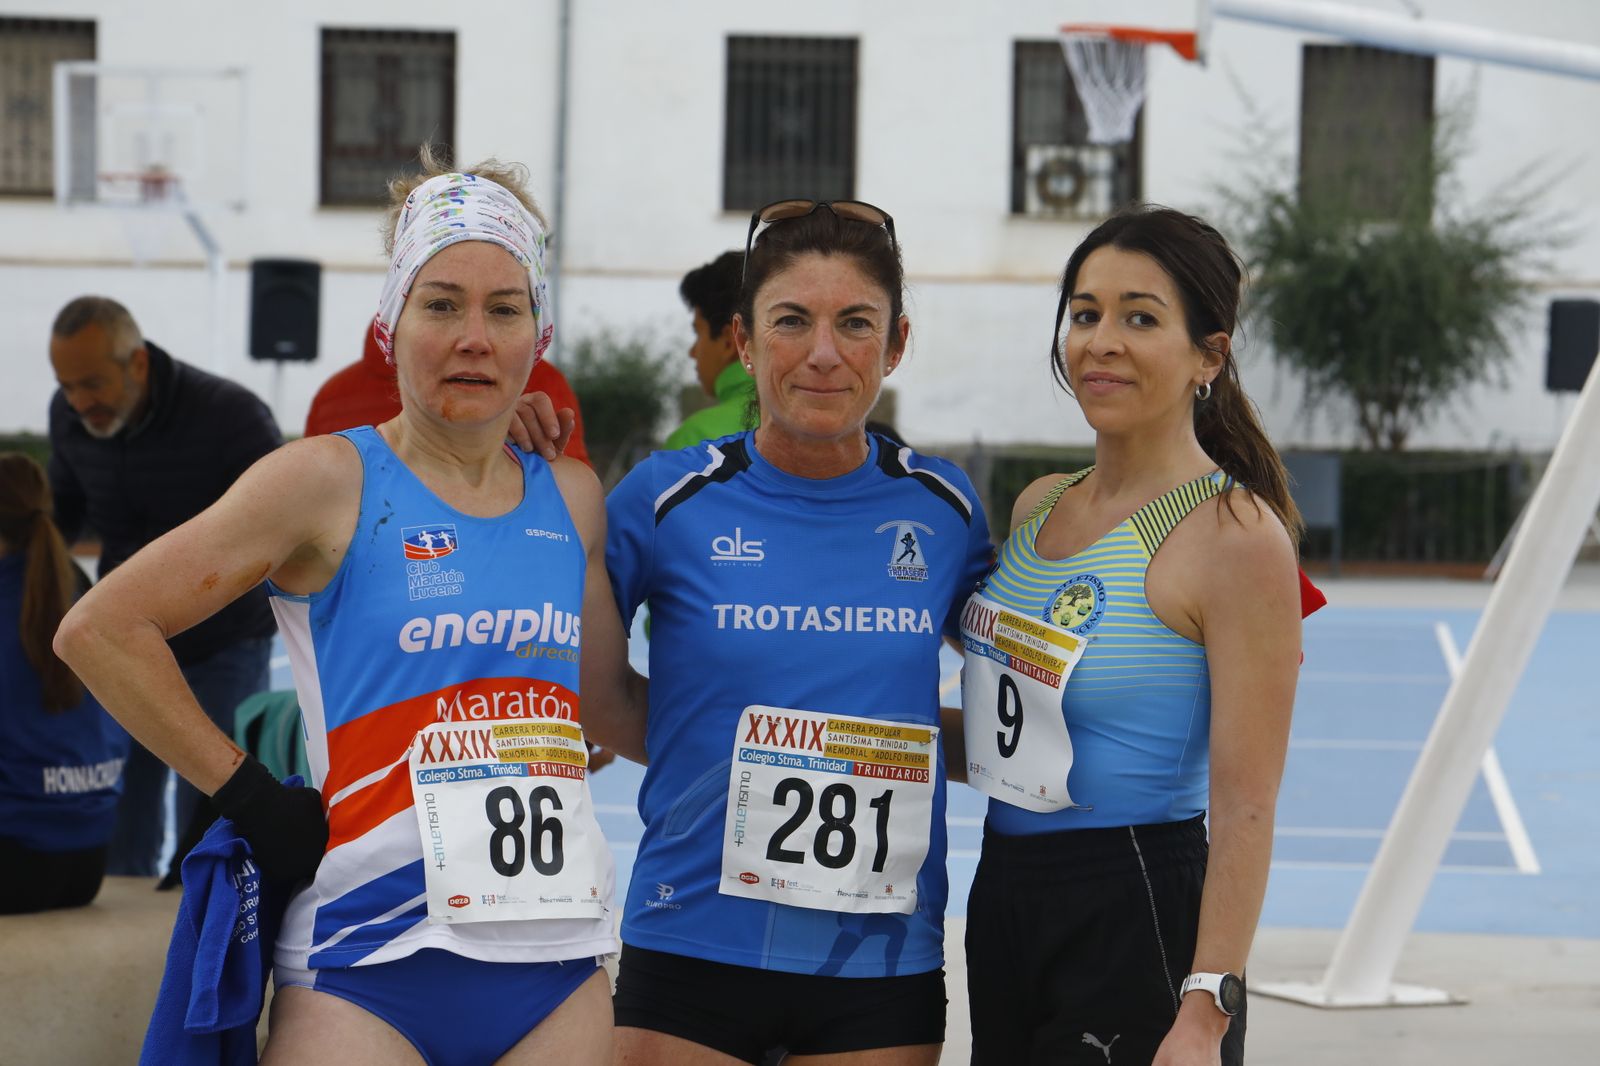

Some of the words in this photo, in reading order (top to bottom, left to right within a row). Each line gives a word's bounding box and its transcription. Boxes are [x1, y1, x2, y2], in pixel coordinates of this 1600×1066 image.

[406, 560, 440, 577] Club
[408, 568, 464, 588] Maratón
[410, 583, 462, 601] Lucena
[399, 602, 582, 653] enerplus
[713, 604, 934, 634] TROTASIERRA
[962, 600, 998, 641] XXXIX
[999, 611, 1022, 627] CARRERA
[1023, 621, 1046, 637] POPULAR
[995, 635, 1018, 653] MEMORIAL
[1024, 633, 1049, 651] TRINIDAD
[1011, 658, 1060, 687] TRINITARIOS
[436, 686, 572, 722] Maratón
[996, 673, 1024, 759] 9
[493, 725, 529, 736] CARRERA
[531, 725, 562, 735] POPULAR
[744, 713, 826, 752] XXXIX
[828, 721, 866, 734] CARRERA
[868, 726, 901, 738] POPULAR
[419, 729, 497, 764] XXXIX
[496, 736, 539, 748] SANTÍSIMA
[542, 736, 569, 747] TRINIDAD
[825, 744, 868, 758] MEMORIAL
[827, 733, 872, 747] SANTÍSIMA
[875, 740, 908, 750] TRINIDAD
[498, 750, 538, 759] MEMORIAL
[740, 750, 776, 765] Colegio
[777, 753, 805, 767] Stma.
[808, 757, 847, 772] Trinidad
[417, 769, 455, 783] Colegio
[457, 767, 486, 778] Stma.
[488, 764, 522, 776] Trinidad
[531, 763, 585, 779] TRINITARIO
[856, 763, 929, 782] TRINITARIOS
[485, 785, 564, 877] 86
[766, 777, 893, 872] 281
